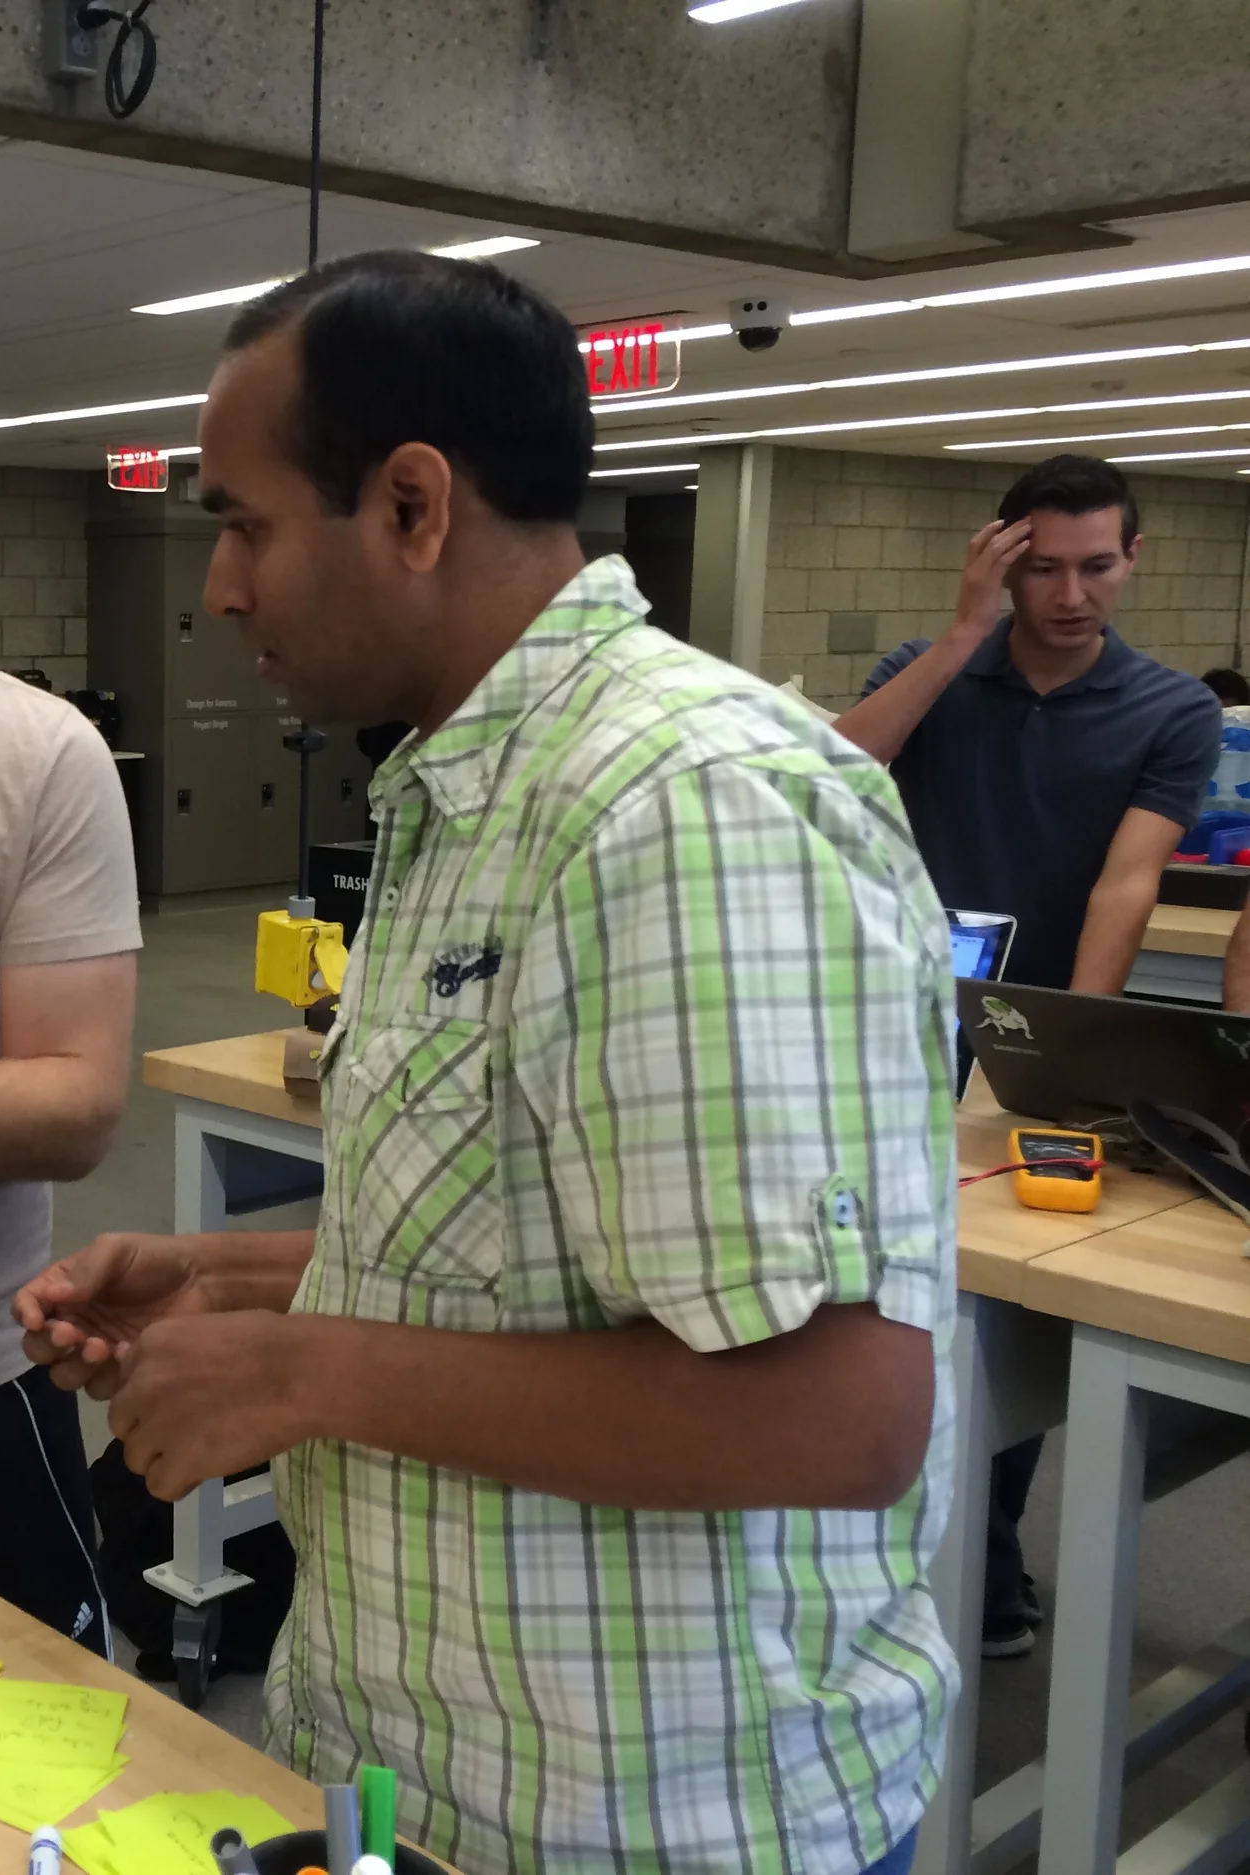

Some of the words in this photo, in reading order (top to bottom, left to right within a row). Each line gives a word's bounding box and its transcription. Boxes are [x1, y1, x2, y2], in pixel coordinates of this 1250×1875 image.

[588, 324, 665, 393] EXIT
[118, 448, 158, 488] EXIT
[333, 873, 370, 892] TRASH
